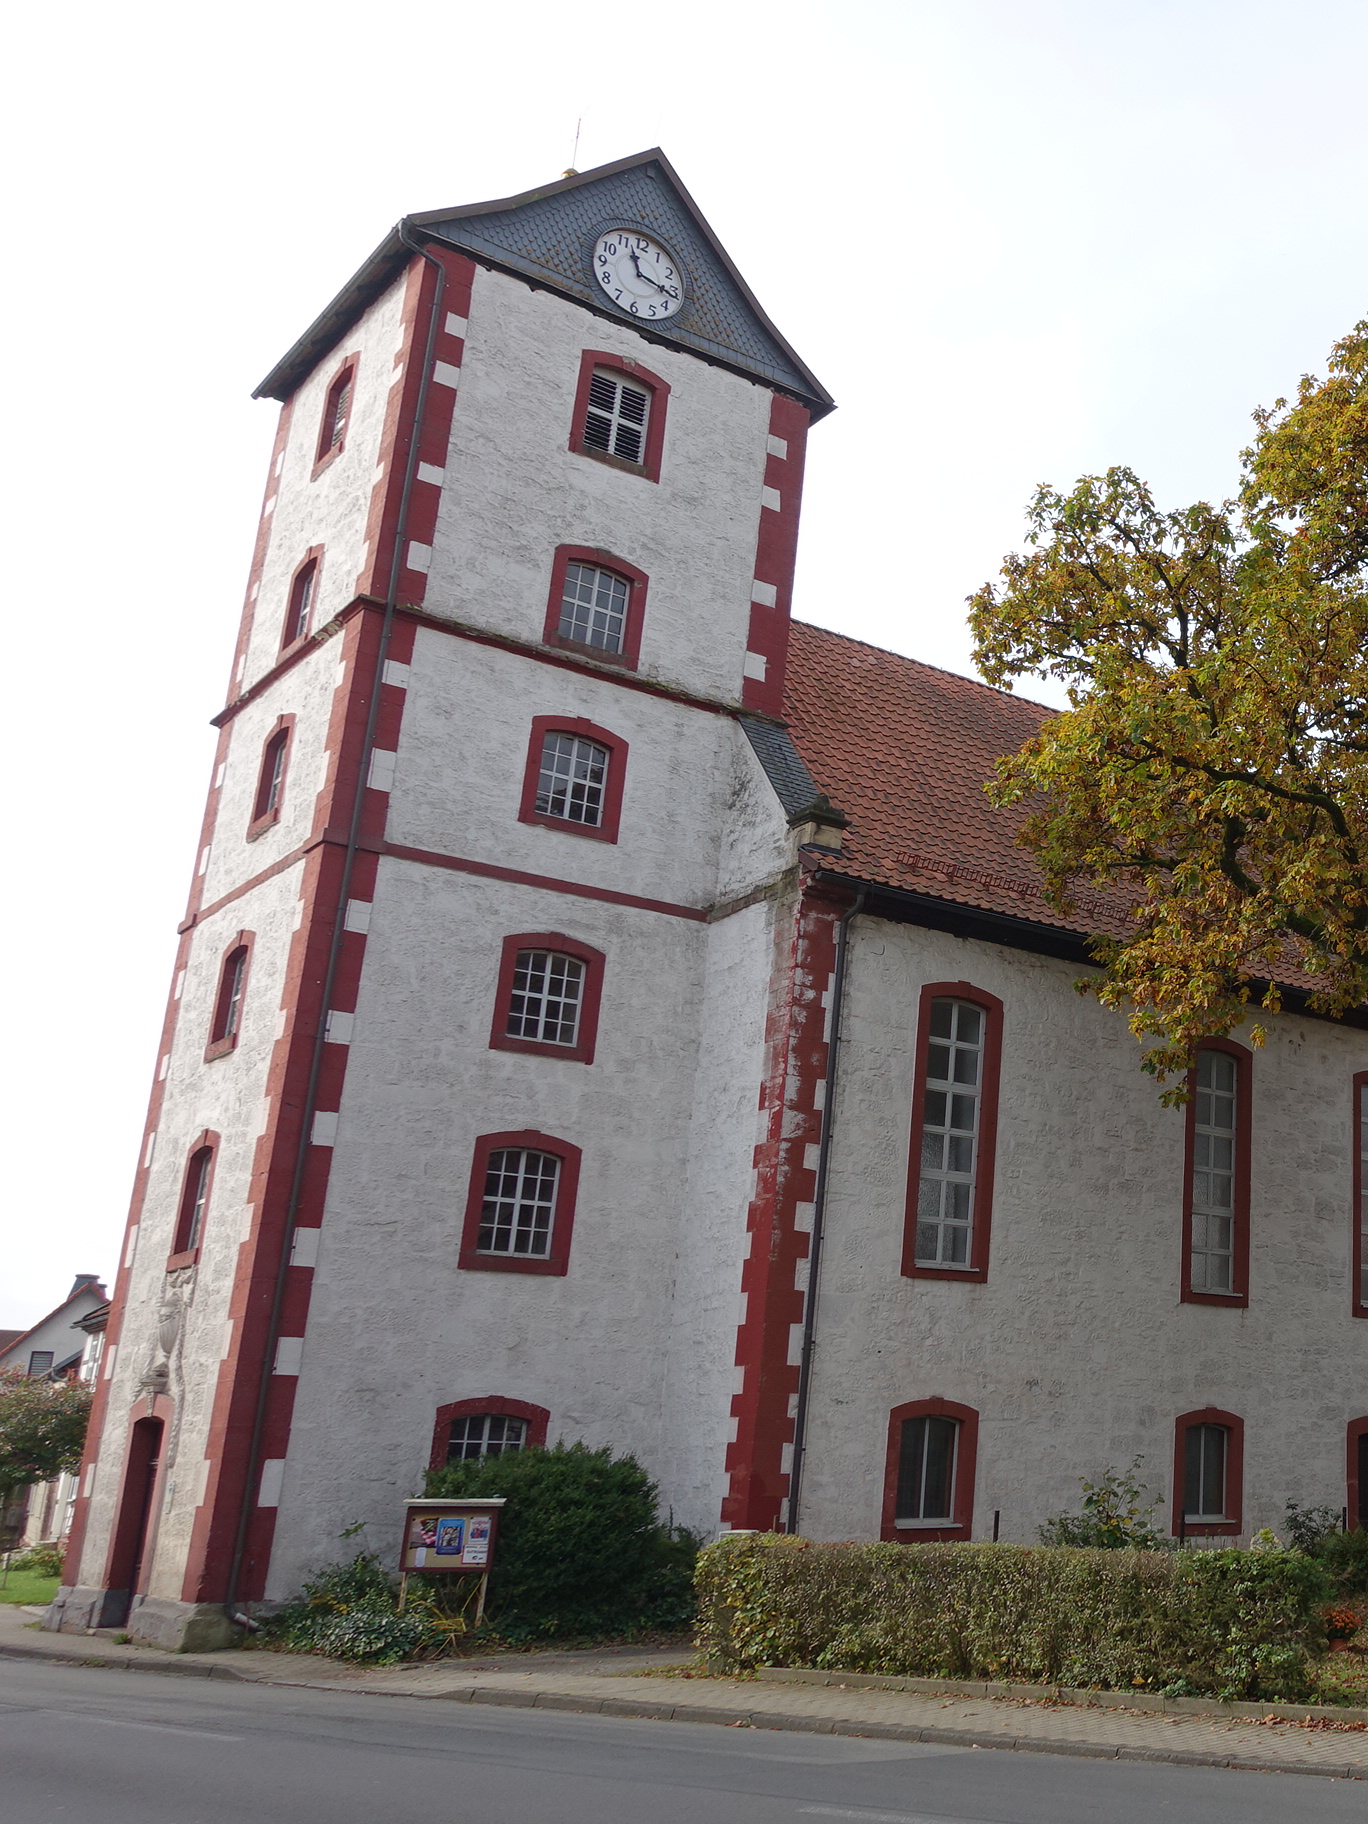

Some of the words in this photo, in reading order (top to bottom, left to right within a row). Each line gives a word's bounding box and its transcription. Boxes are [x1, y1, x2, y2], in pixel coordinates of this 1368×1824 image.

[617, 234, 629, 248] 11
[635, 237, 649, 253] 12
[603, 241, 616, 256] 10
[598, 254, 607, 267] 9
[655, 252, 660, 263] 1
[602, 271, 611, 284] 8
[665, 267, 673, 280] 2
[614, 288, 623, 300] 7
[669, 285, 678, 298] 3
[630, 301, 638, 314] 6
[648, 304, 657, 317] 5
[660, 300, 669, 312] 4
